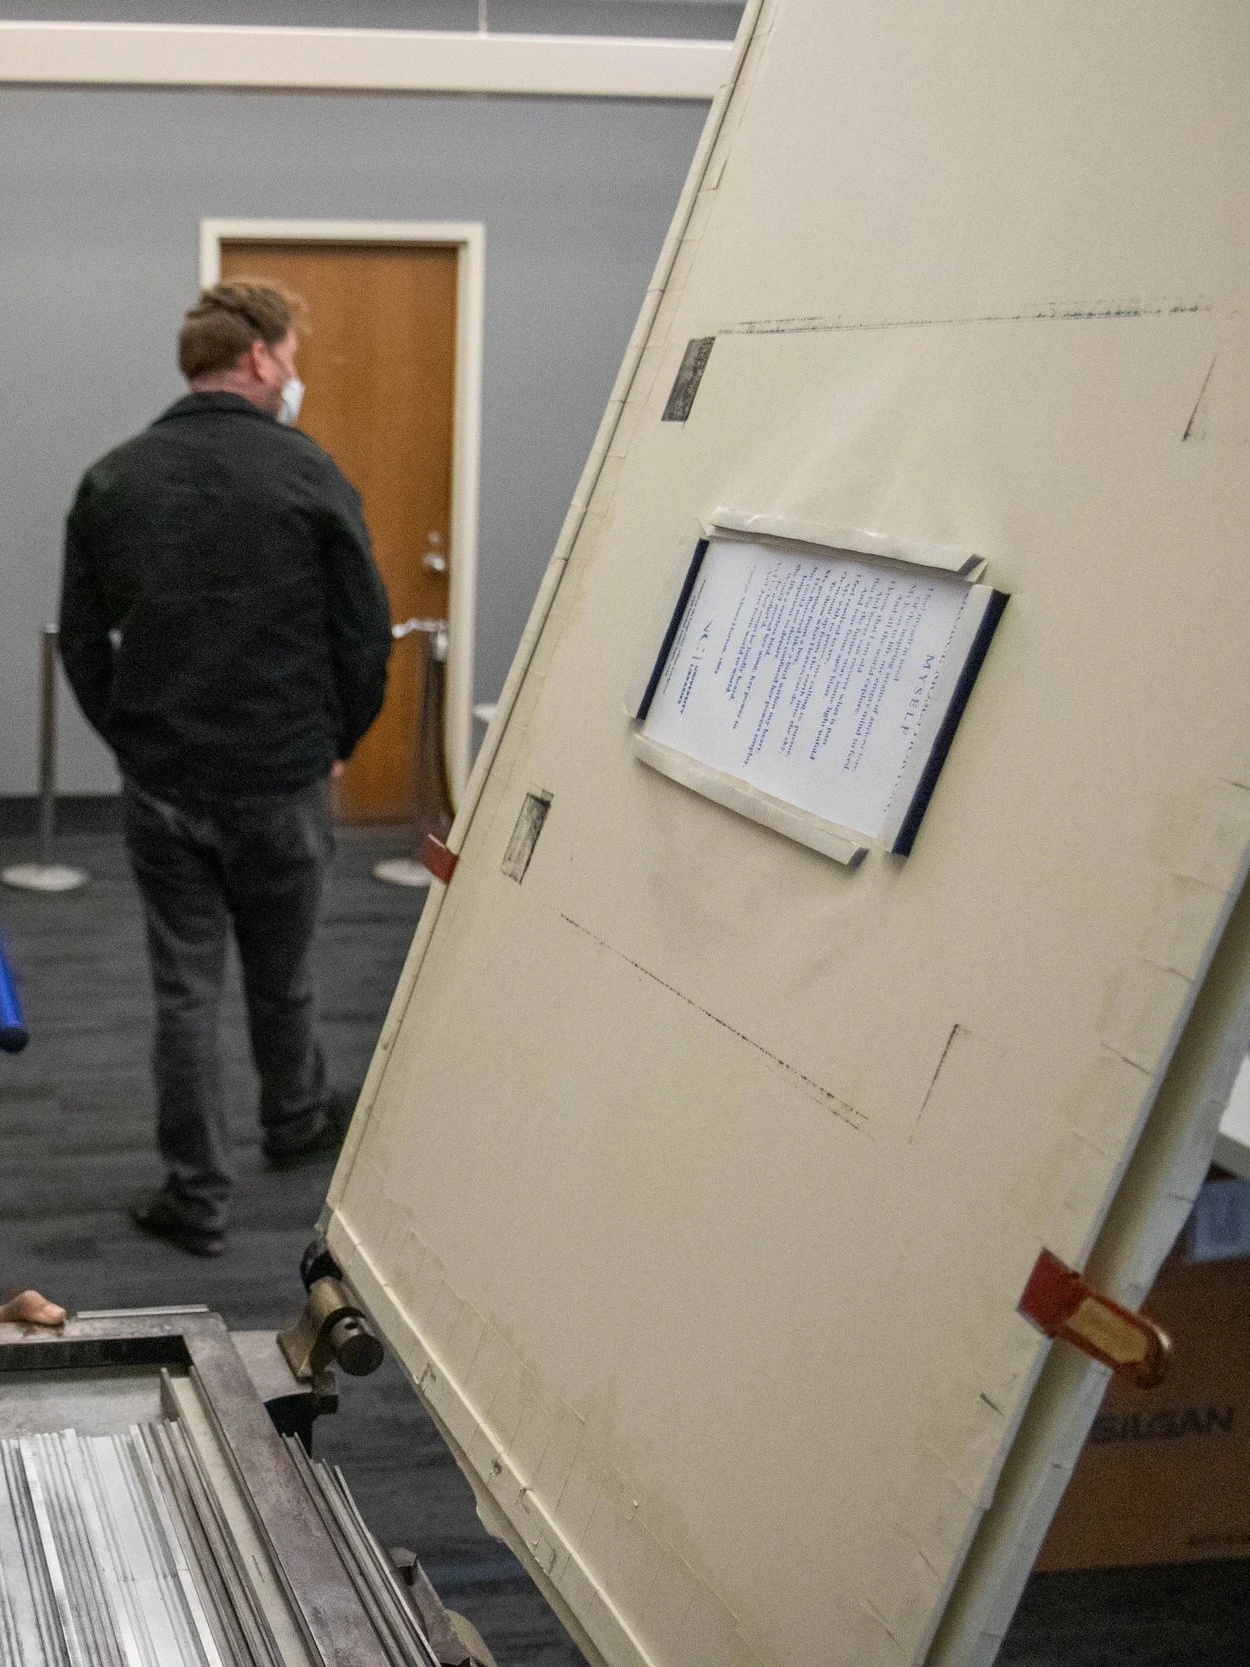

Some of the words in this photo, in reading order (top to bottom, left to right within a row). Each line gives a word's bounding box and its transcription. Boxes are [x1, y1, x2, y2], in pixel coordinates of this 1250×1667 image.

[781, 661, 791, 679] bird
[868, 649, 881, 675] world
[677, 664, 693, 703] LIBRARIES
[680, 665, 698, 714] UNIVERSITY
[747, 675, 755, 690] her
[768, 684, 776, 698] her
[901, 654, 934, 735] MYSELF
[736, 692, 748, 718] power
[821, 707, 832, 726] light
[833, 693, 844, 715] what
[809, 730, 822, 760] unfold
